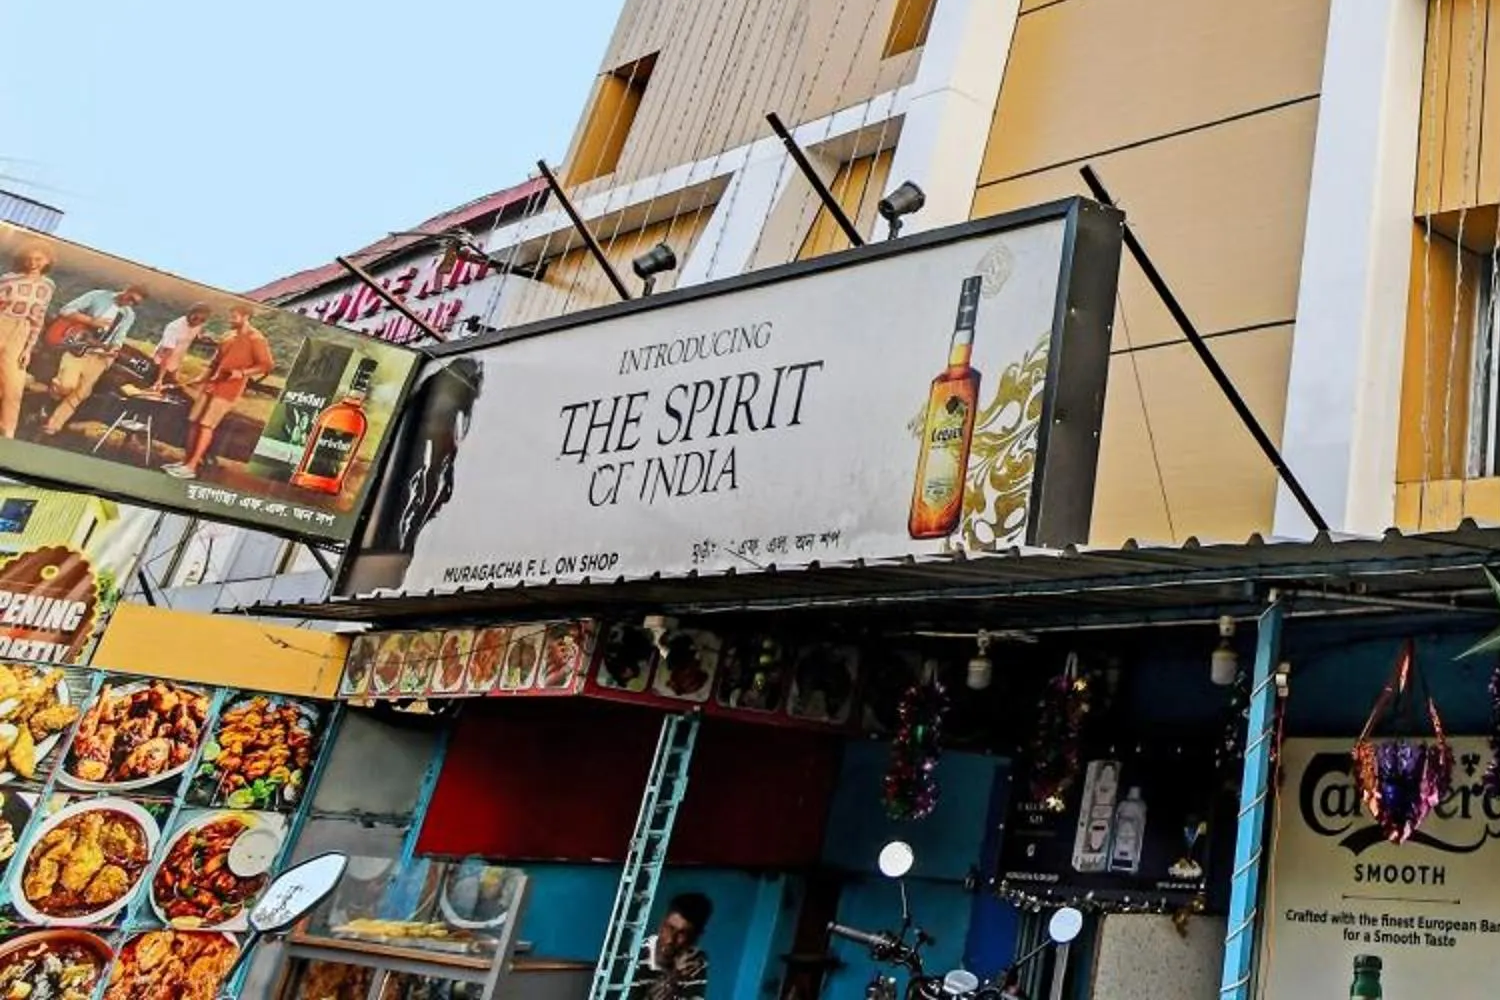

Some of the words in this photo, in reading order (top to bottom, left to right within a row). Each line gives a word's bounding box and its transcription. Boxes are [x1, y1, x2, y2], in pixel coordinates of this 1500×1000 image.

[618, 321, 773, 375] INTRODUCING
[558, 391, 650, 465] THE
[656, 360, 825, 447] SPIRIT
[639, 446, 739, 505] INDIA
[443, 560, 523, 583] MURAGACHA
[555, 556, 577, 575] ON
[579, 552, 619, 572] SHOP
[1353, 864, 1446, 886] SMOOTH
[1285, 909, 1328, 924] Crafted
[1331, 911, 1356, 926] with
[1359, 912, 1379, 927] the
[1382, 913, 1415, 929] finest
[1417, 916, 1477, 934] European
[1343, 927, 1360, 941] for
[1364, 932, 1371, 942] a
[1374, 930, 1421, 946] Smooth
[1425, 933, 1457, 948] Taste
